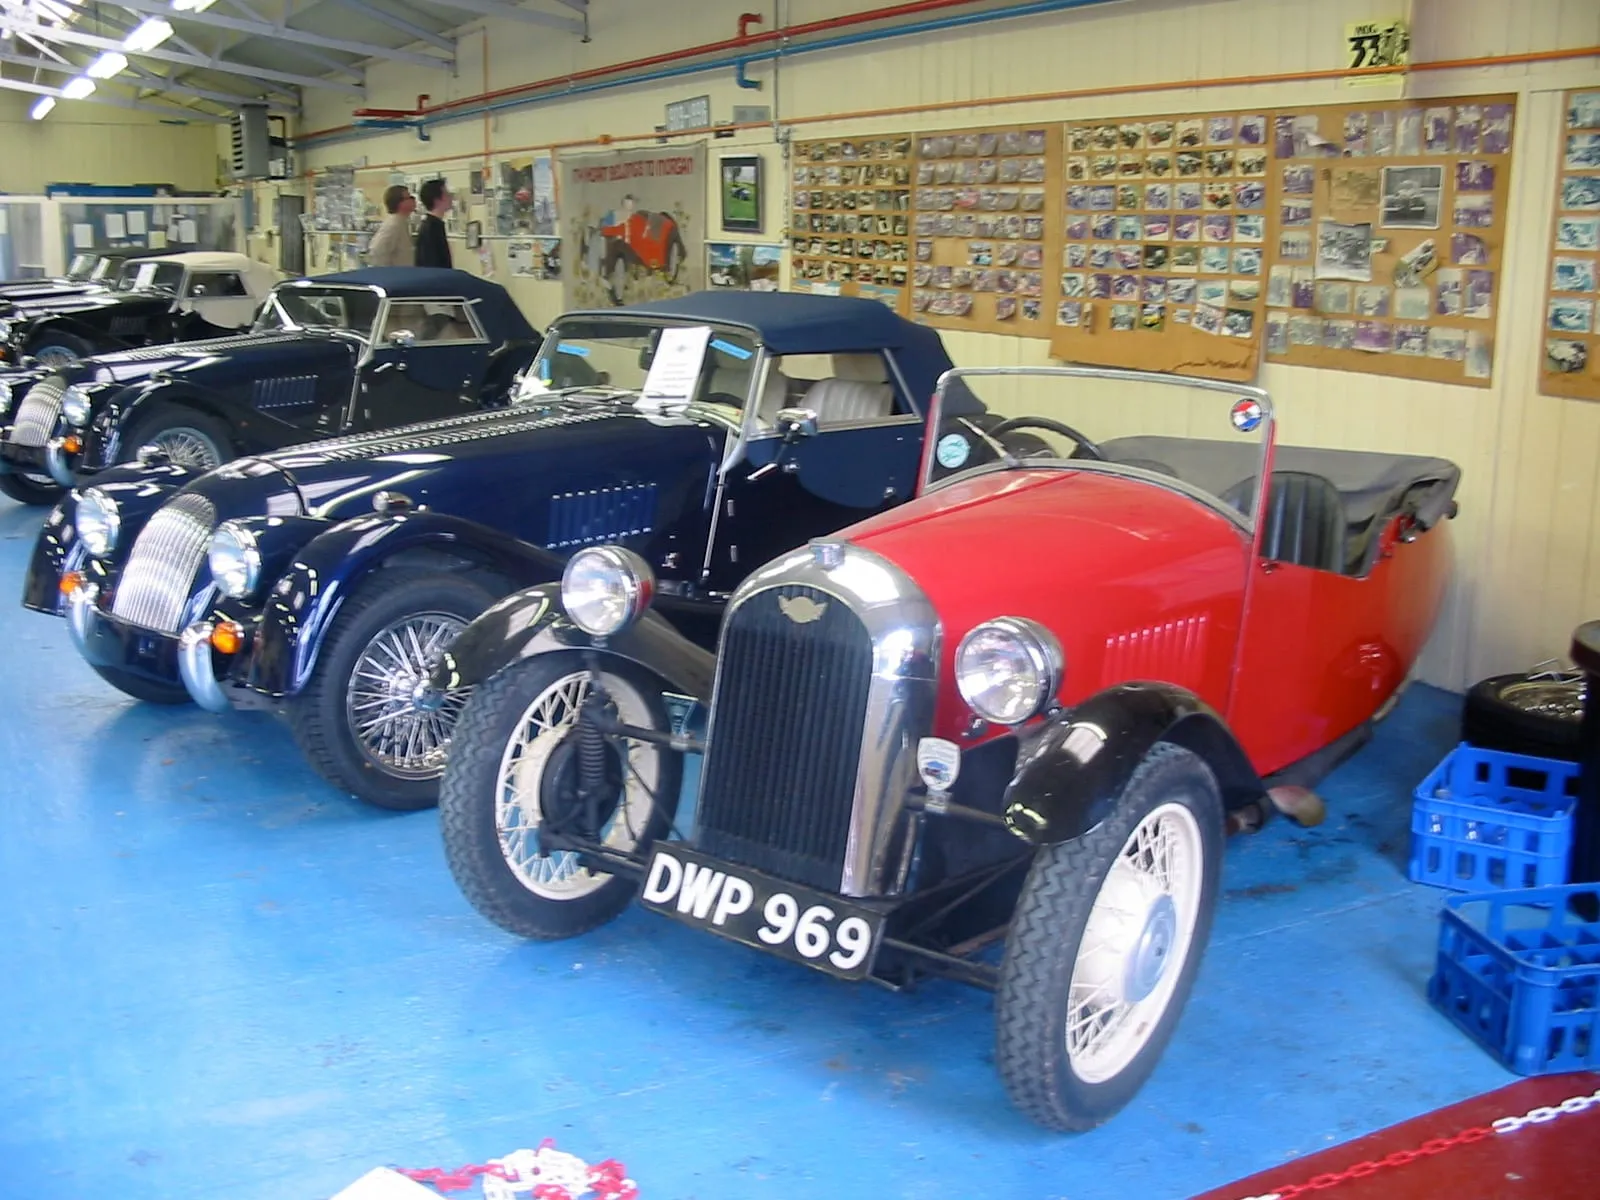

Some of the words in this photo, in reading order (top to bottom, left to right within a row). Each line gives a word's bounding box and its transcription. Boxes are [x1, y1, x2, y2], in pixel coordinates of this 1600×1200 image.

[655, 156, 693, 176] MORGAN
[642, 852, 754, 925] DWP
[757, 893, 871, 970] 969
